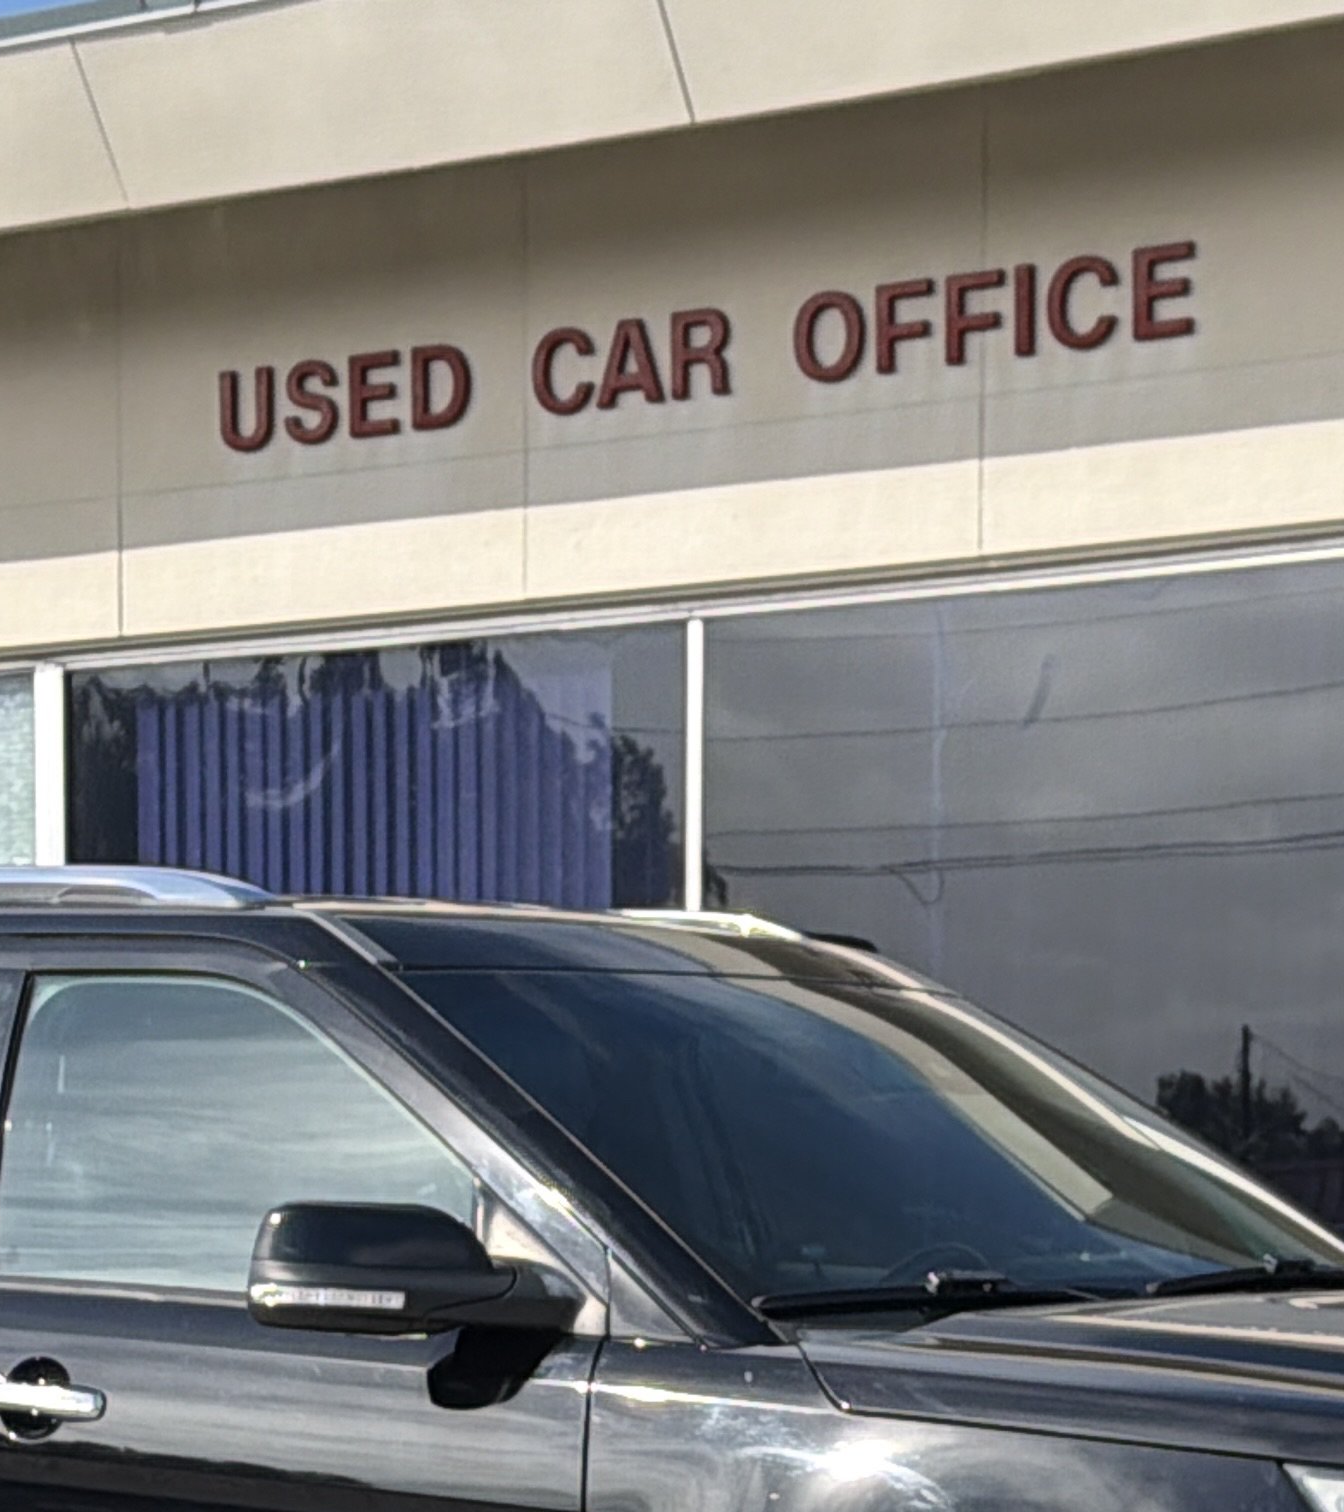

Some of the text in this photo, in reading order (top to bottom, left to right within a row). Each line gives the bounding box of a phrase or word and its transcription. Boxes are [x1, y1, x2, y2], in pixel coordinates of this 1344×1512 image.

[219, 240, 1196, 452] USED CAR OFFICE
